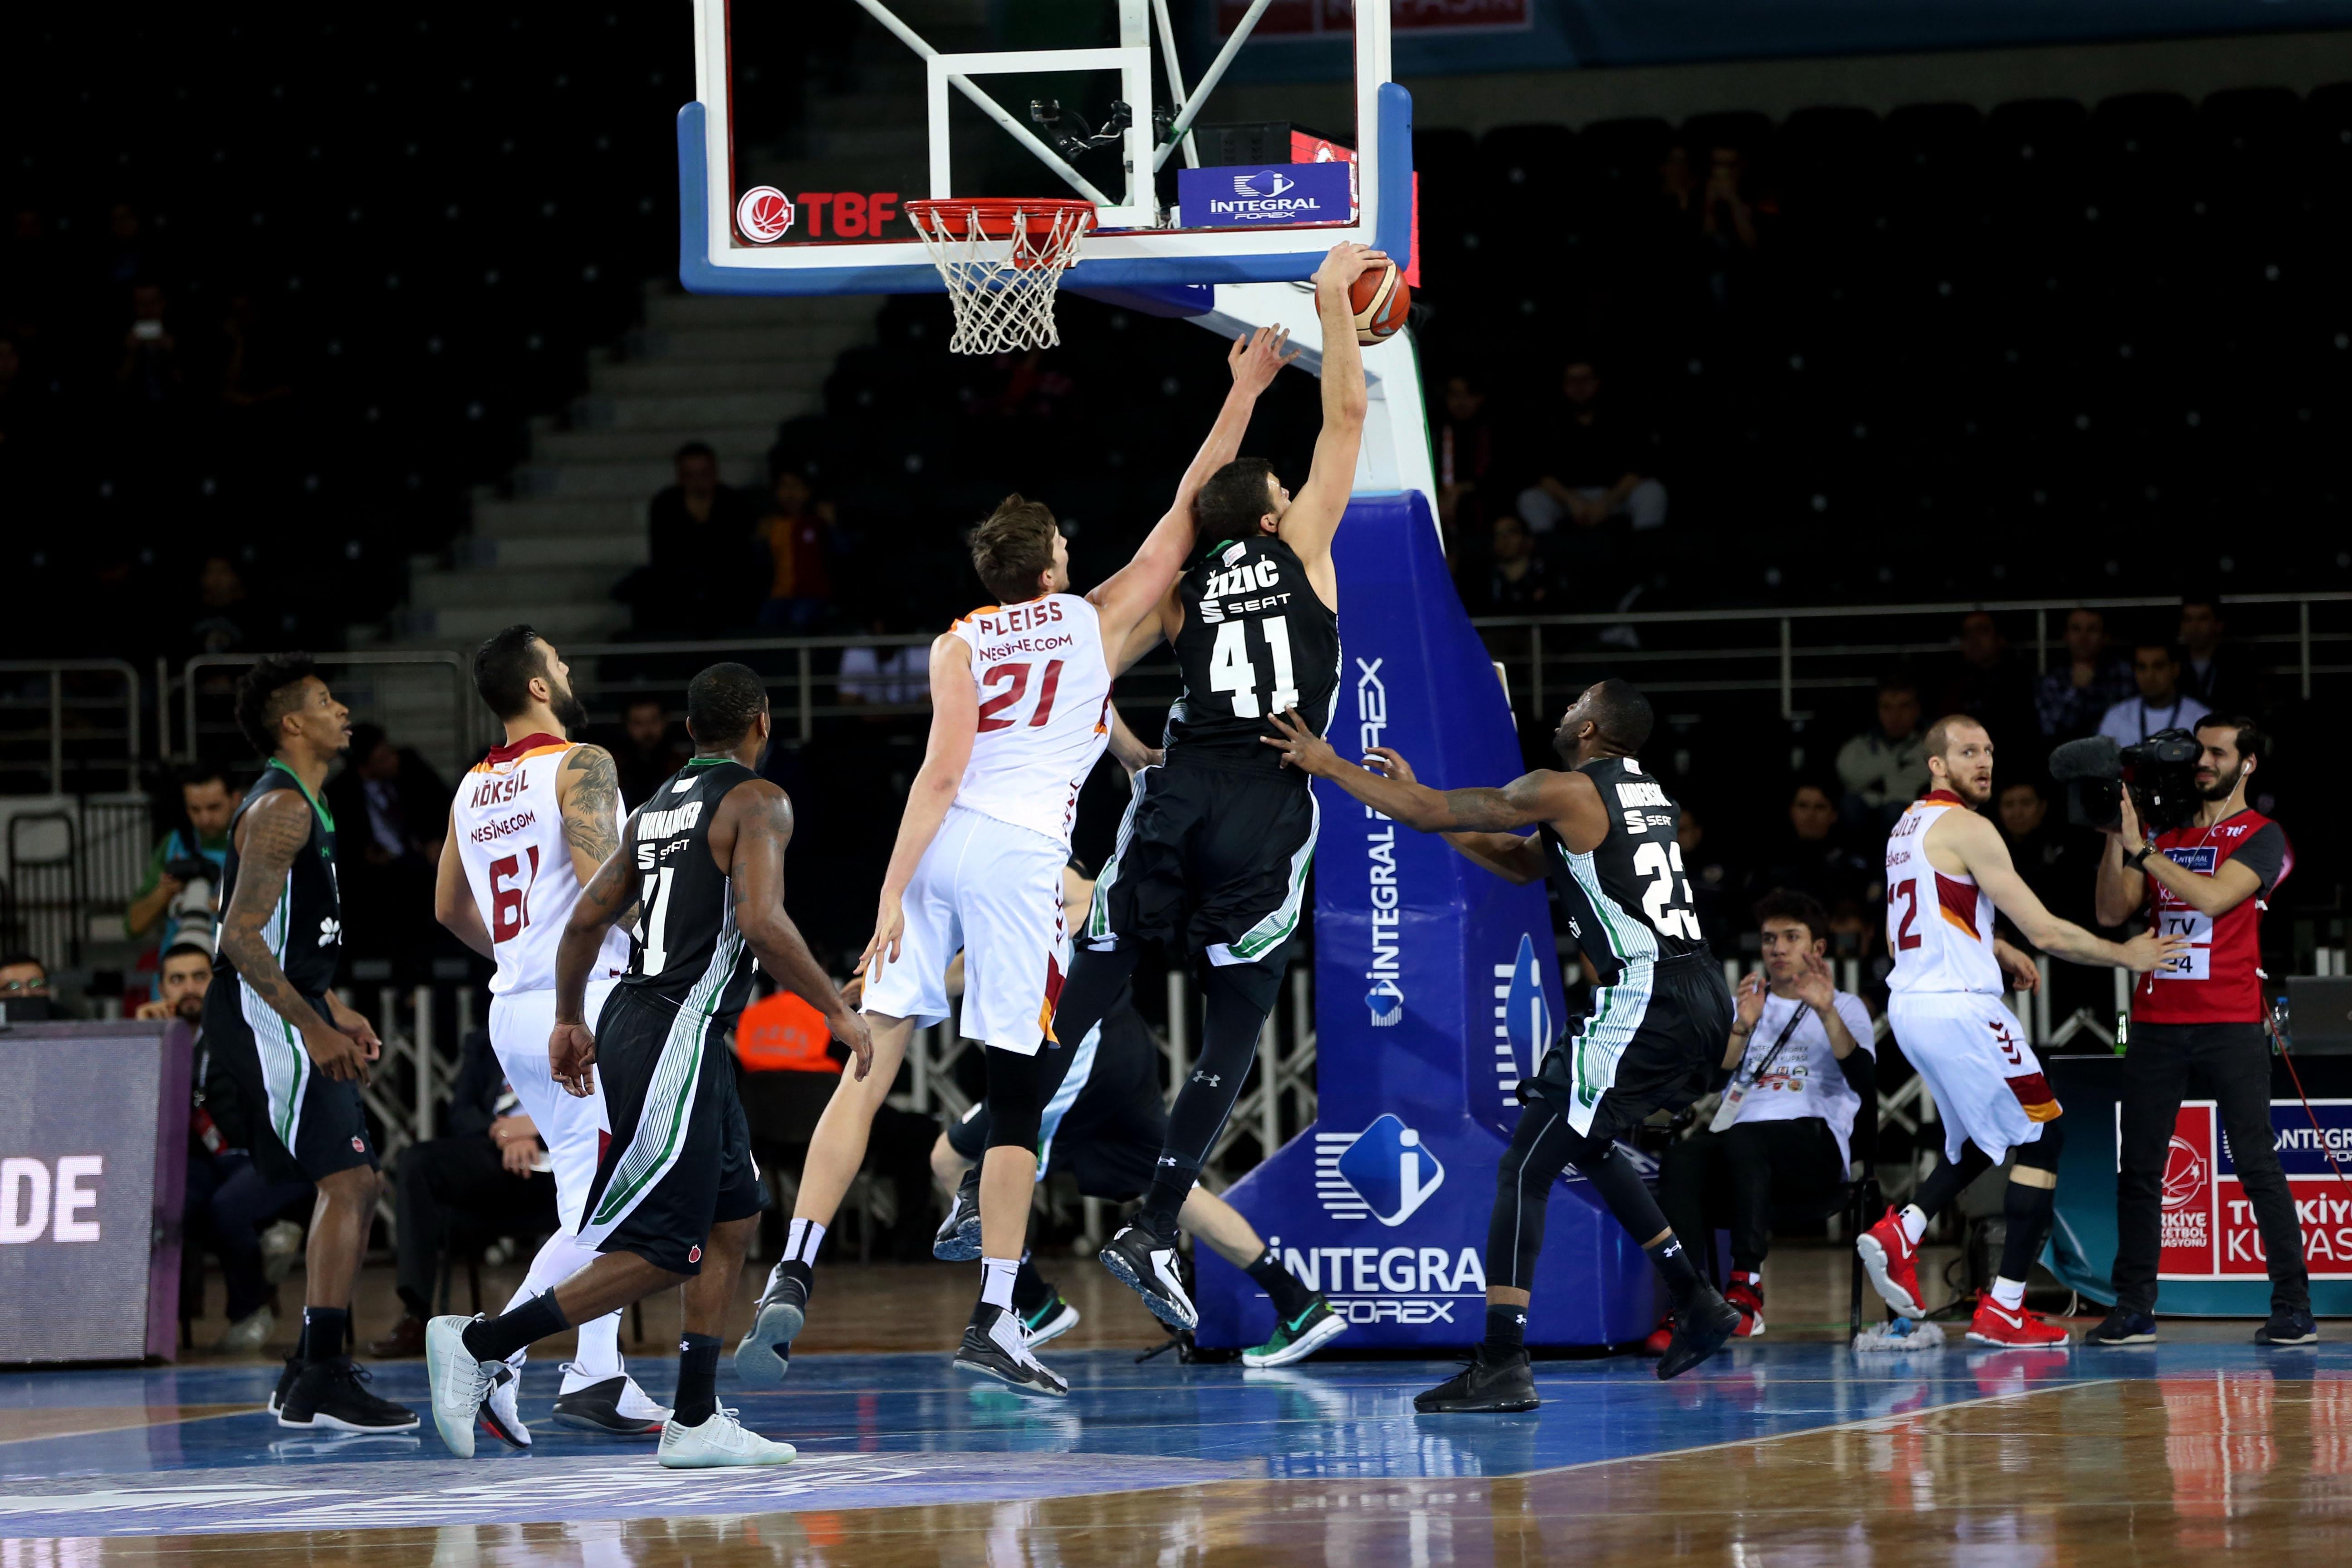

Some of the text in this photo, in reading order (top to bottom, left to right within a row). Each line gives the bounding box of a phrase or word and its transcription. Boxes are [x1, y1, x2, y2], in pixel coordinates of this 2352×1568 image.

[797, 192, 898, 237] TBF
[1234, 211, 1296, 220] FOREX
[980, 602, 1063, 636] PLEISS
[1228, 593, 1291, 613] SEAT
[1210, 615, 1299, 718] 41
[977, 659, 1065, 733] 21
[490, 844, 539, 944] 61
[2168, 918, 2196, 936] TV
[0, 1155, 103, 1245] DE
[1328, 1300, 1455, 1324] FOREX
